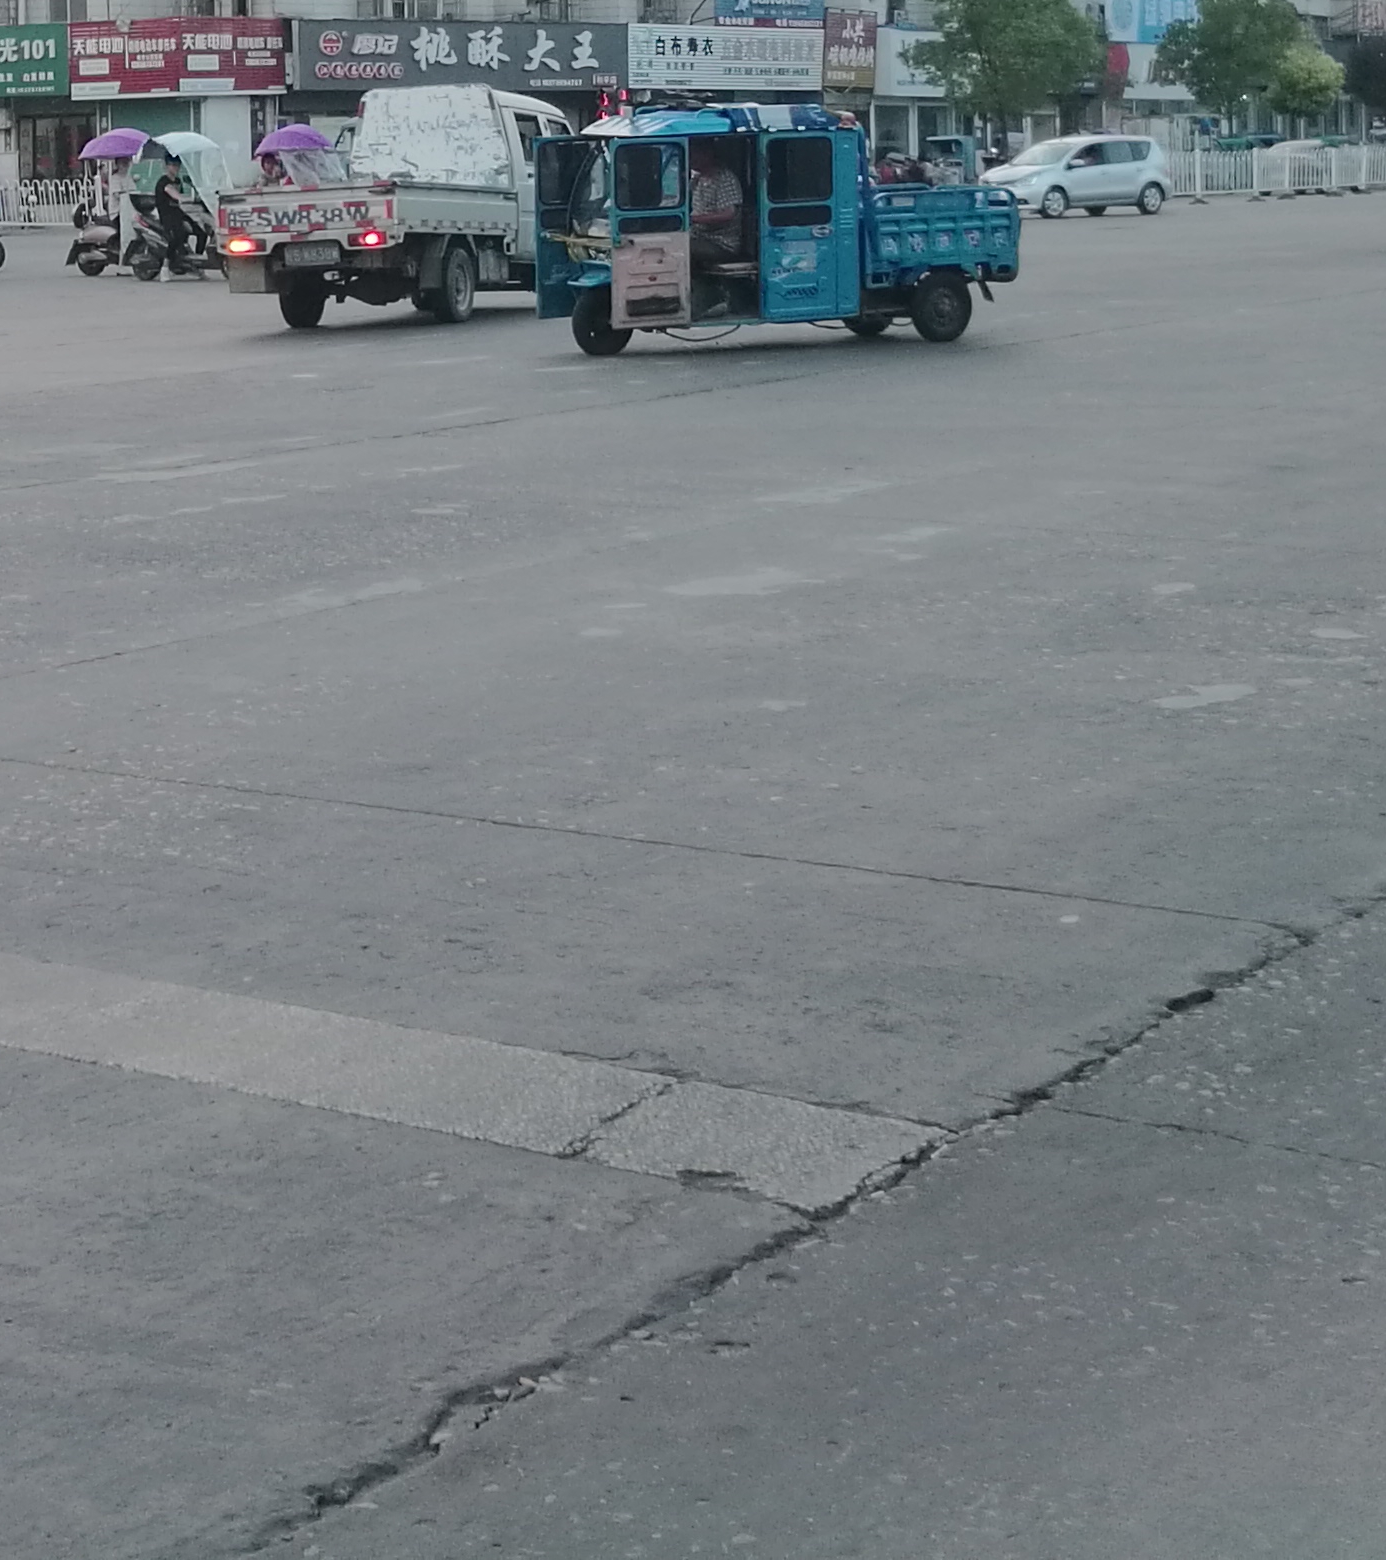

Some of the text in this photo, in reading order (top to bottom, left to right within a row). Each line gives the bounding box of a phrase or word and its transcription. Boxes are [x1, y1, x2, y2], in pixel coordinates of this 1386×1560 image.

[73, 37, 124, 56] 天能电池
[182, 33, 233, 50] 天能电池
[410, 26, 600, 72] 桃酥大王
